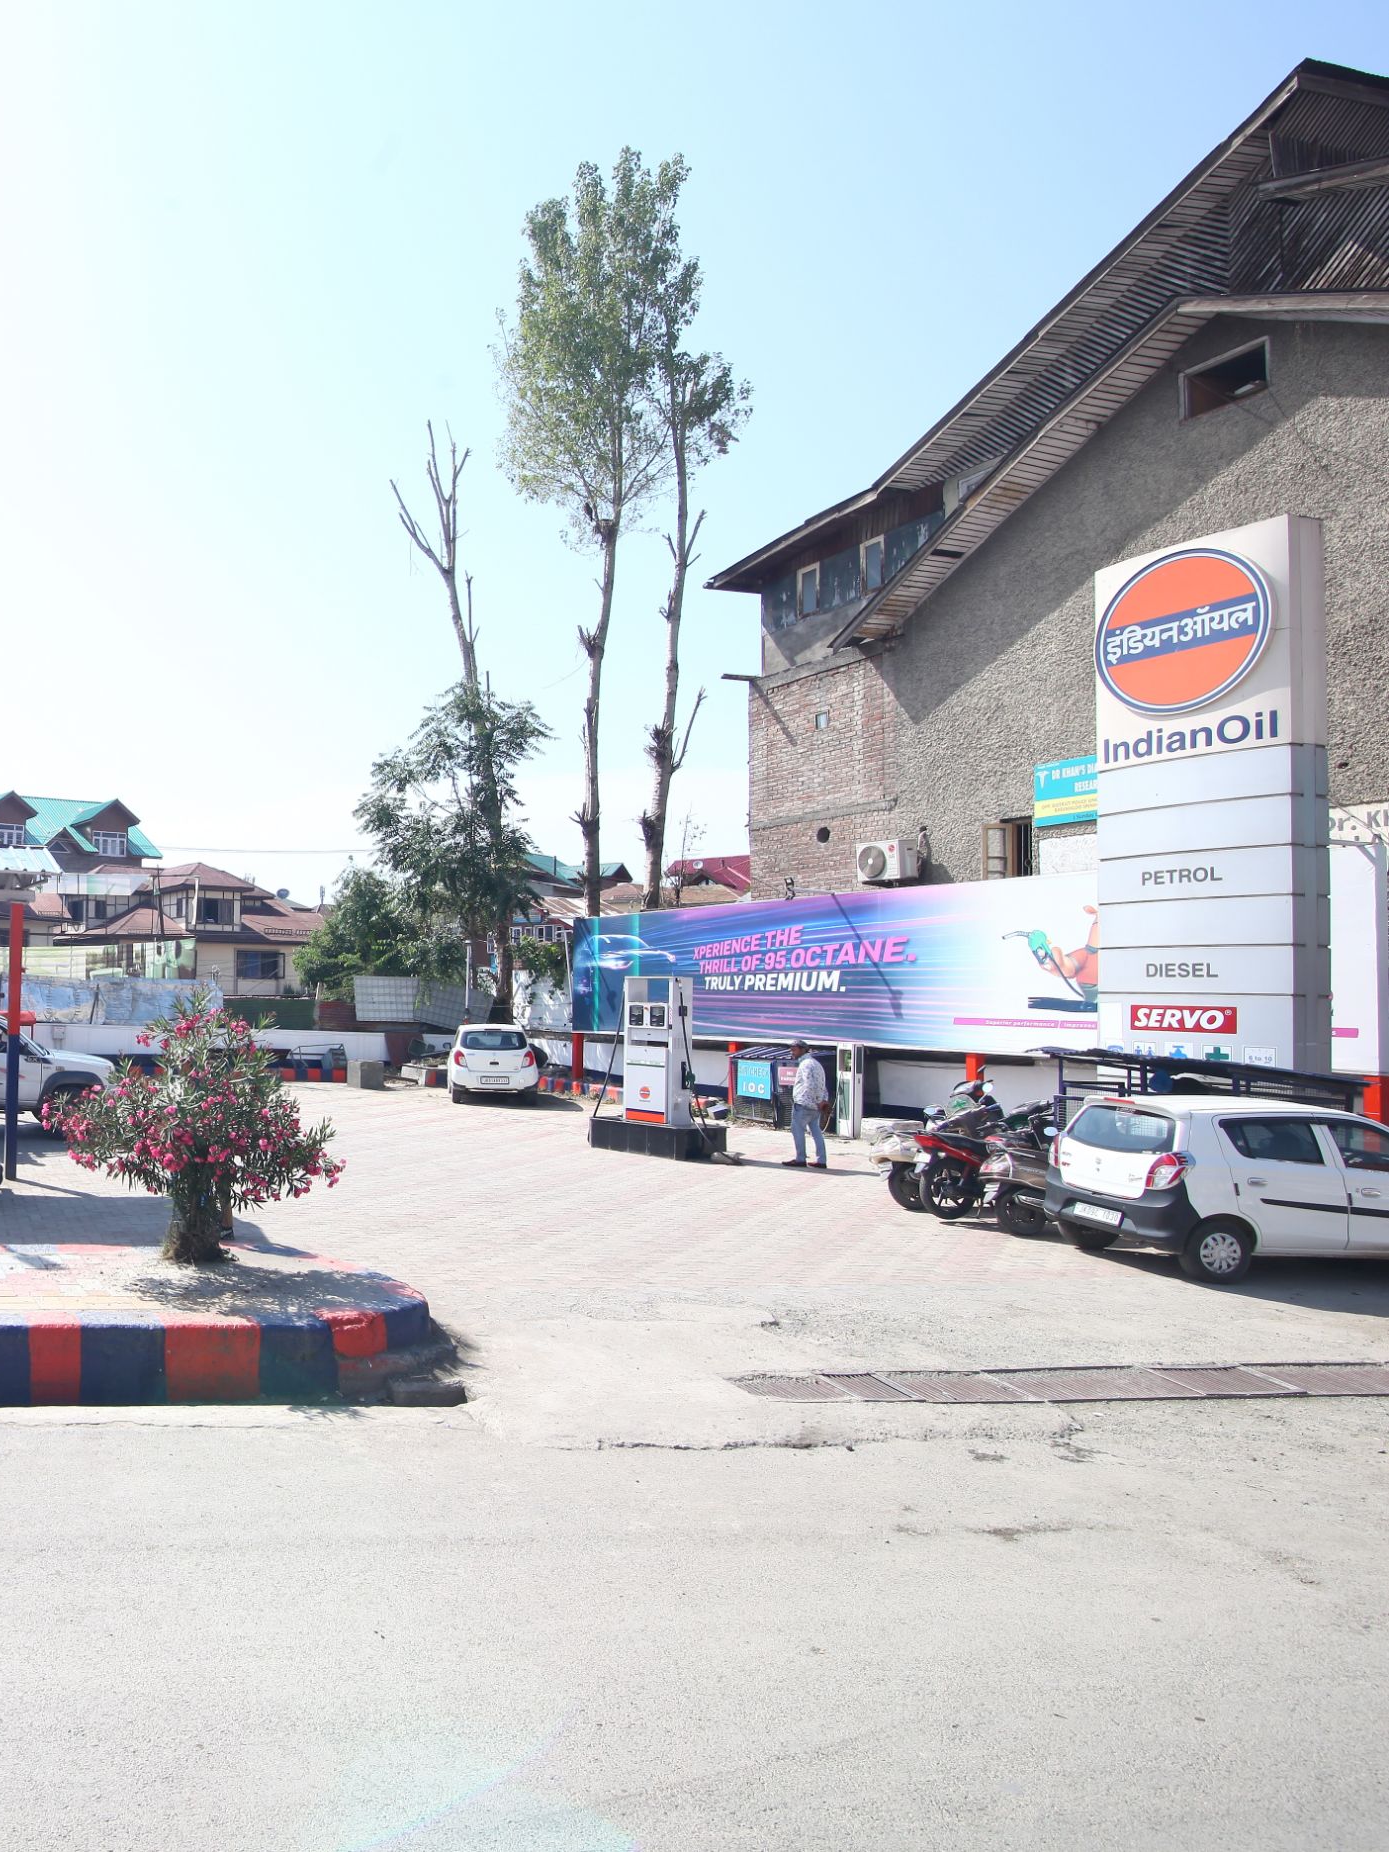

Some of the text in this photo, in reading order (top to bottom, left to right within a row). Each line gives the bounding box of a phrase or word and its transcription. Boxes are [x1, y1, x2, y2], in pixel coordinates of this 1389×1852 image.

[1106, 601, 1257, 665] इंडियनऑयल
[1103, 709, 1279, 765] IndianOil
[1141, 865, 1223, 887] PETROL
[693, 925, 804, 960] XPERIENCE THE
[699, 936, 917, 975] THRILL OF 95 OCTANE.
[704, 970, 847, 992] TRULY PREMIUM.
[1145, 962, 1219, 979] DIESEL
[985, 1019, 1055, 1029] Superior performance
[1134, 1007, 1225, 1030] SERVO
